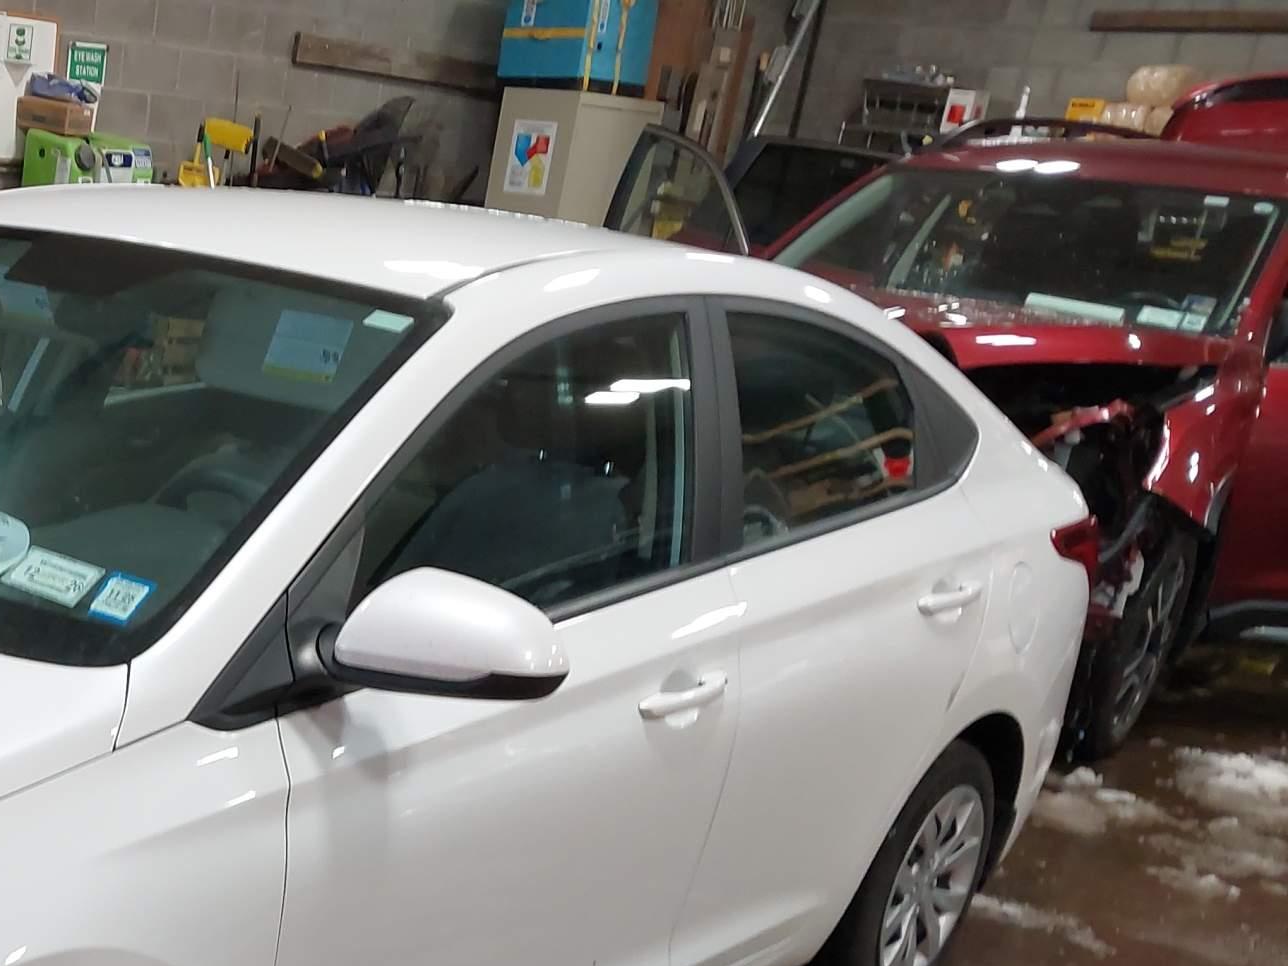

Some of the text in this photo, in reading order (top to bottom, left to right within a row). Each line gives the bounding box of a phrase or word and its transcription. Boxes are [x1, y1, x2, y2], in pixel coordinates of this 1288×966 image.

[73, 49, 102, 64] EYE WASH
[75, 64, 99, 78] STATION
